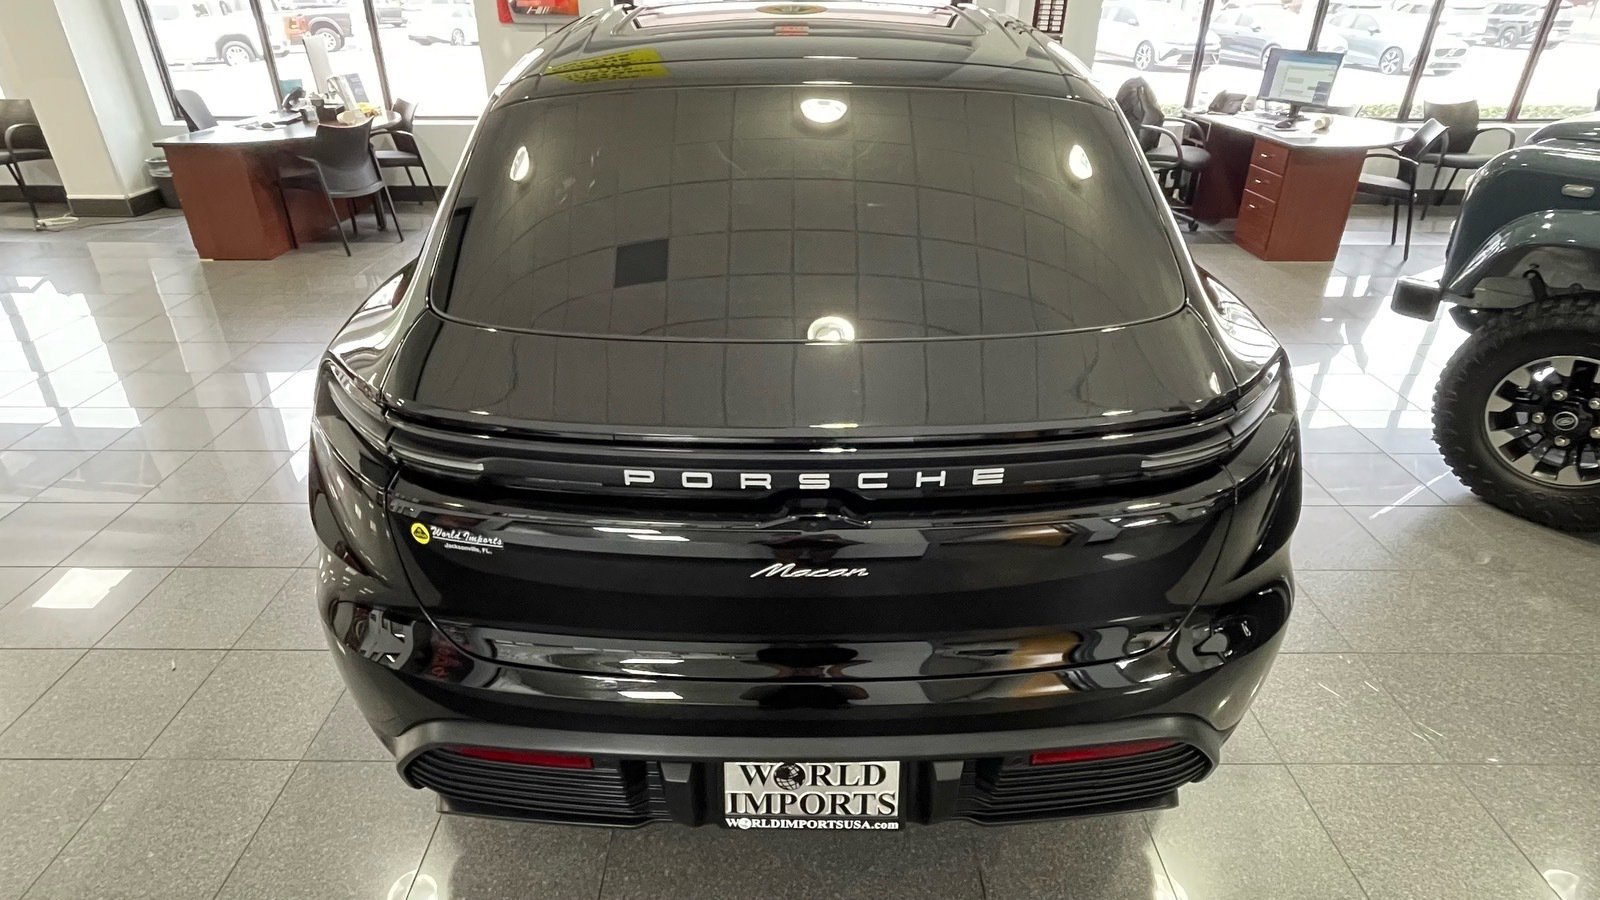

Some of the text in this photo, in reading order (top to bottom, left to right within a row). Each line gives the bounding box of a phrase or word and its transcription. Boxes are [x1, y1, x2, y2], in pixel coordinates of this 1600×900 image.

[624, 467, 1005, 490] PORSCHE
[430, 526, 502, 546] World Imports
[750, 562, 869, 579] Macan
[740, 762, 887, 791] WORLD
[726, 792, 896, 816] IMPORTS
[725, 817, 899, 830] WORLDIMPORTSUSA.com
